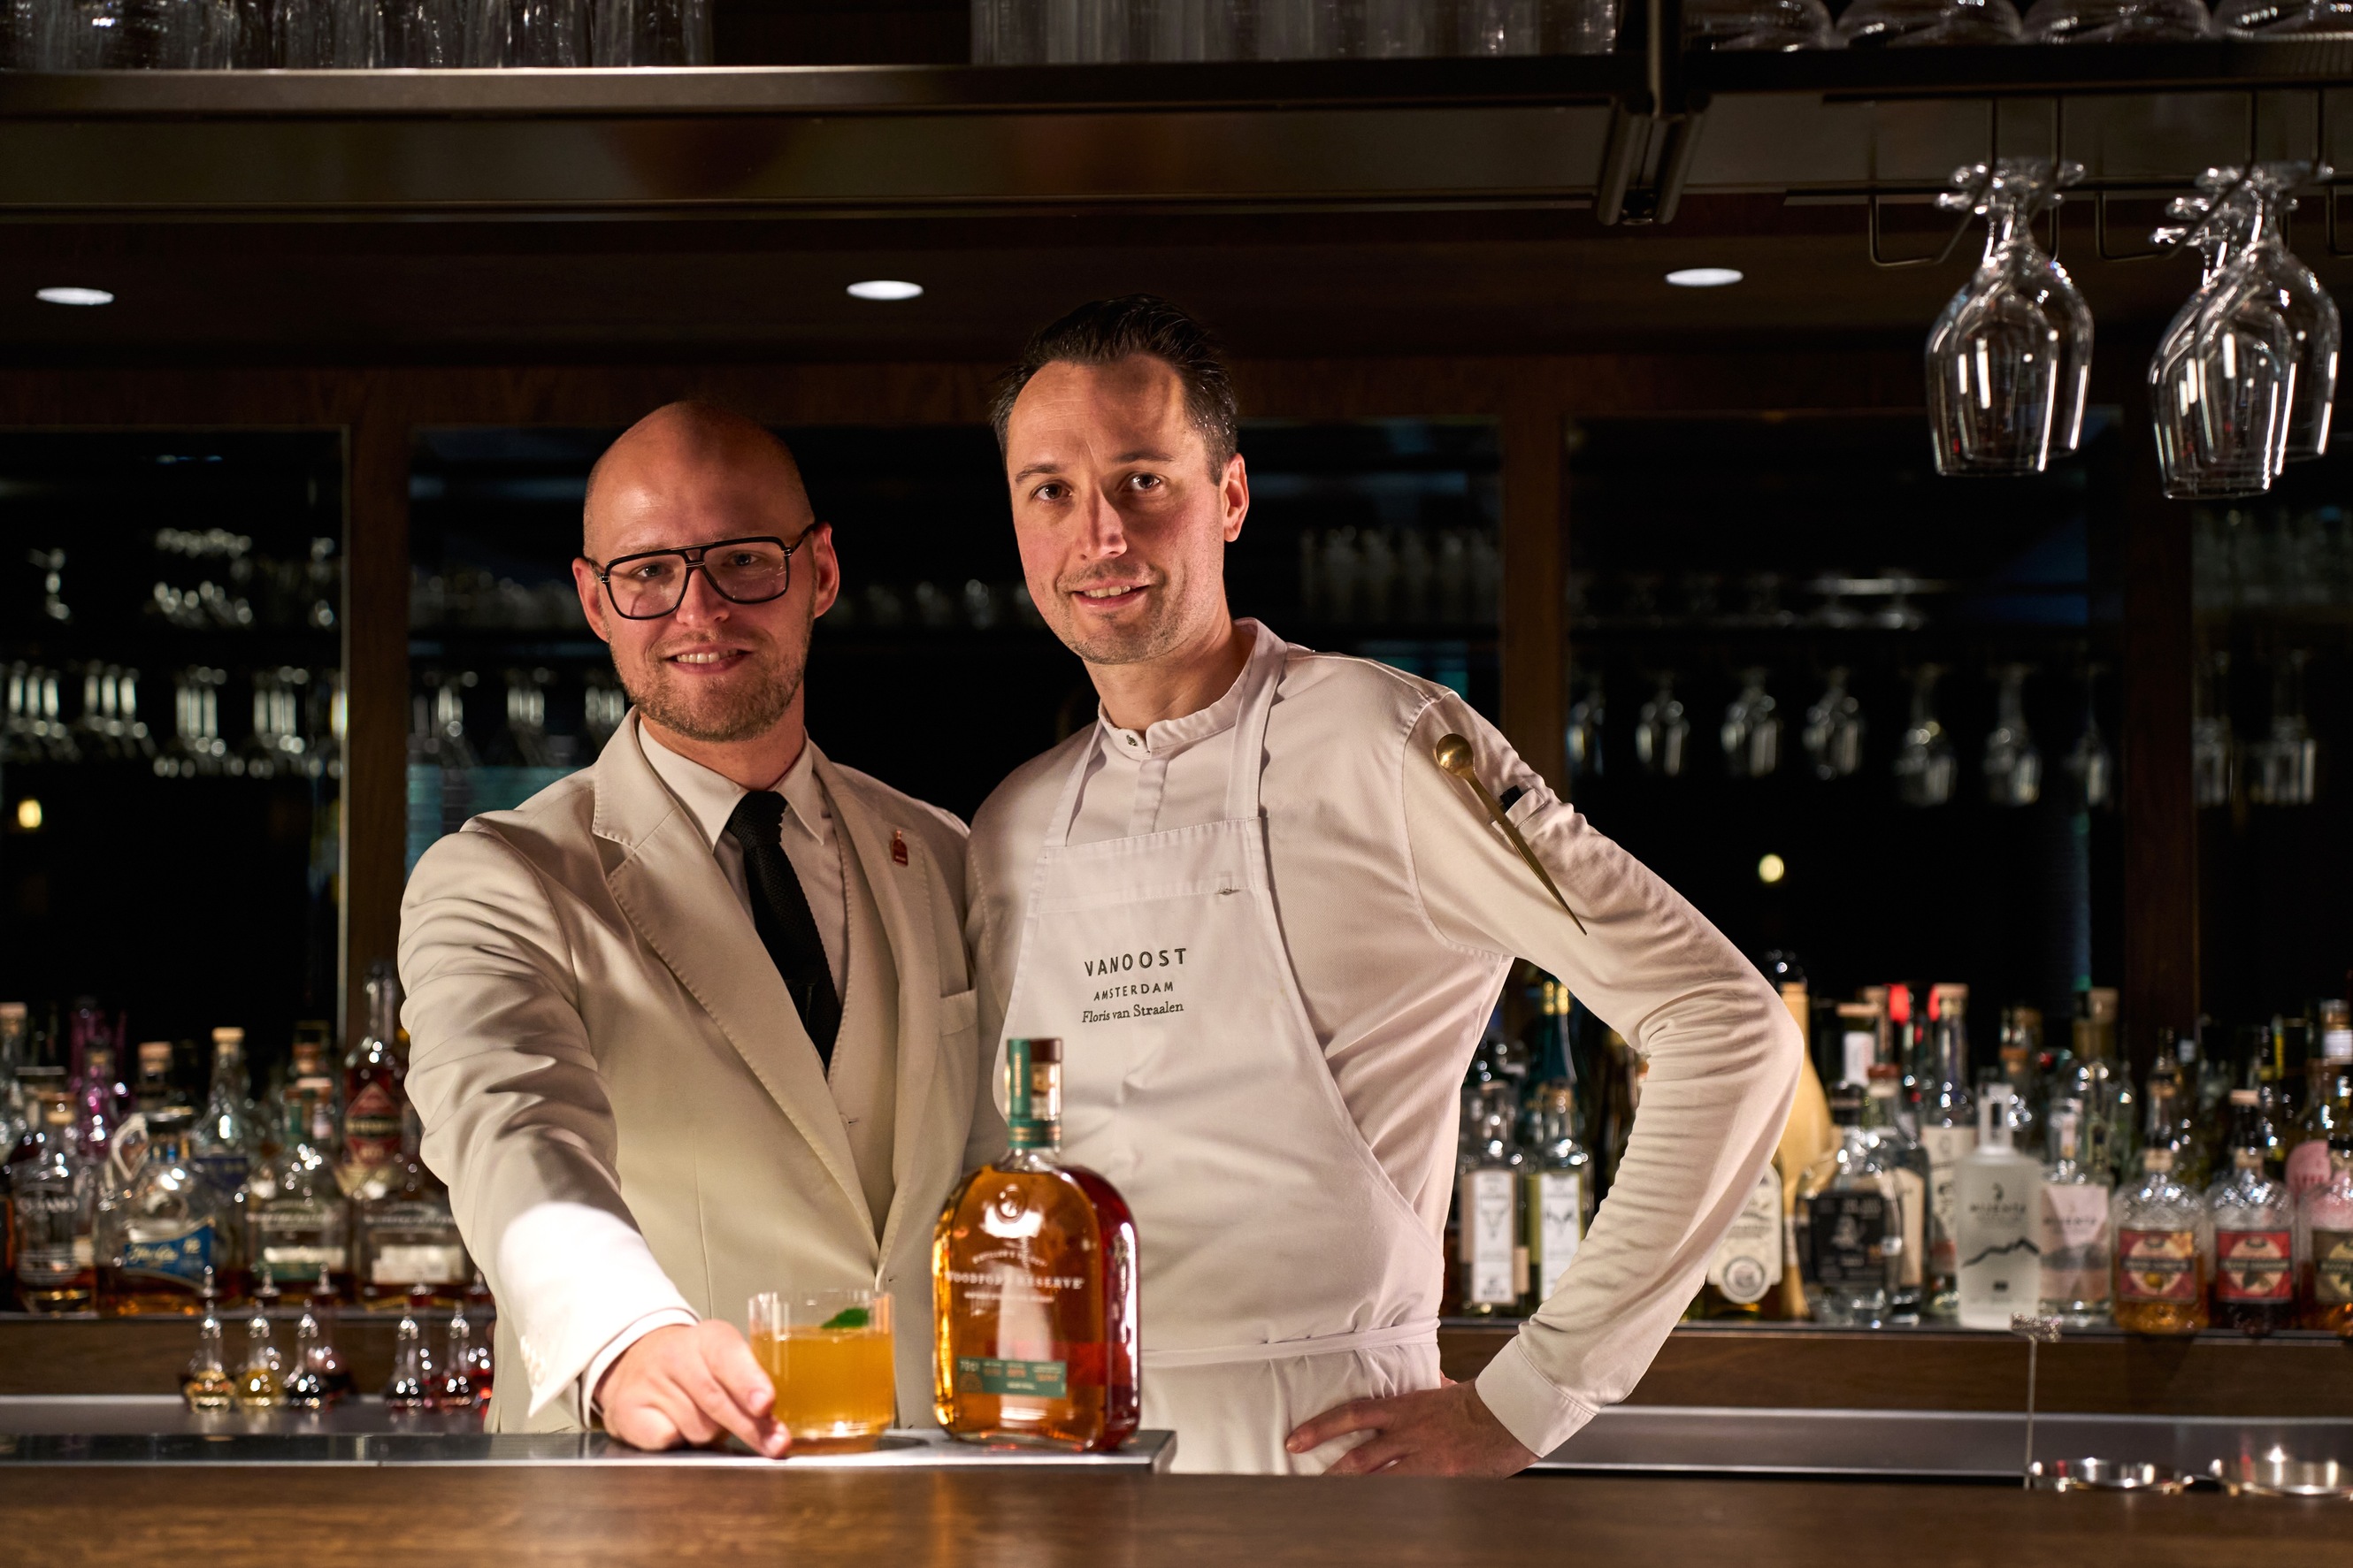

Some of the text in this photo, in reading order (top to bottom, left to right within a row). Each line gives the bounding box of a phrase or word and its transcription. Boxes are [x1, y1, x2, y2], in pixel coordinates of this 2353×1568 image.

[1084, 947, 1187, 976] VANOOST
[1093, 981, 1174, 1001] AMSTERDAM
[1081, 1001, 1184, 1023] Floris van Straalen
[946, 1271, 1014, 1285] WOODFOR
